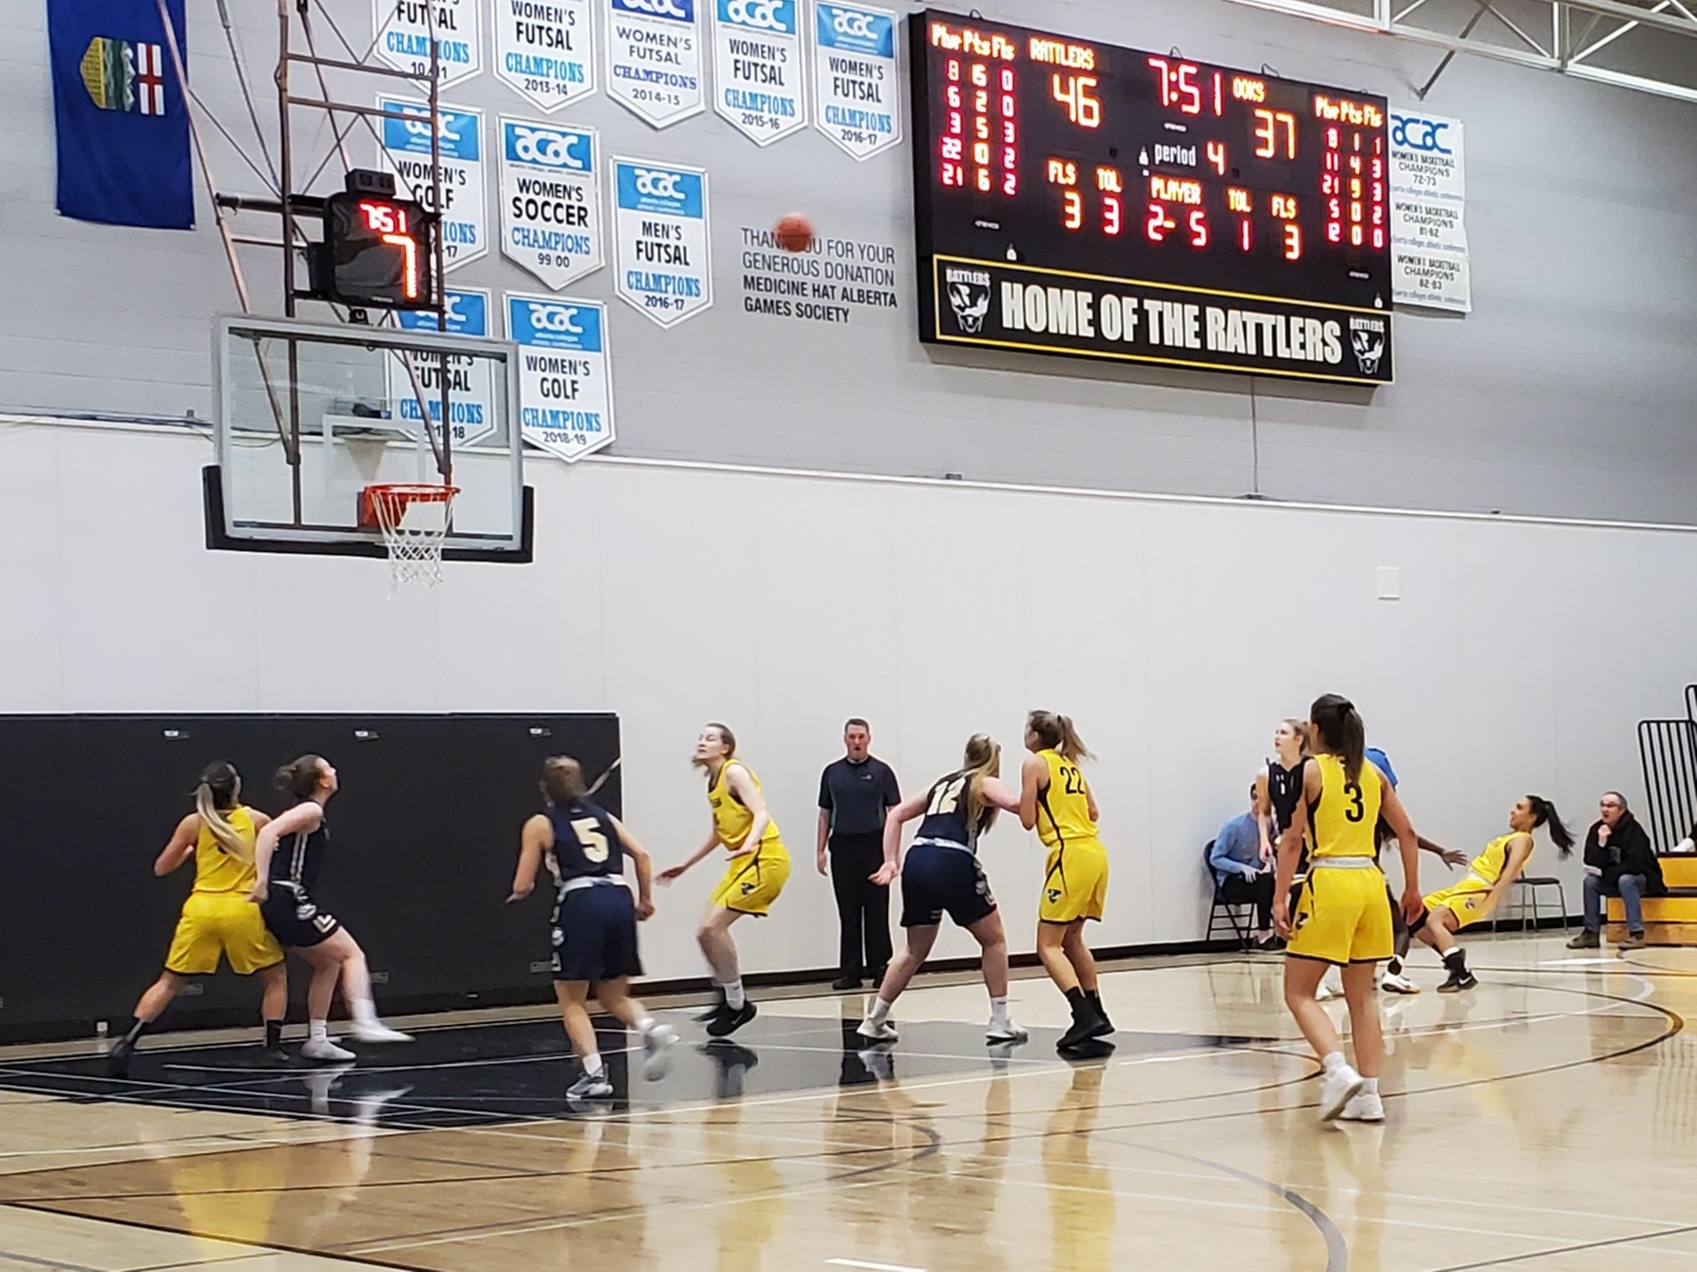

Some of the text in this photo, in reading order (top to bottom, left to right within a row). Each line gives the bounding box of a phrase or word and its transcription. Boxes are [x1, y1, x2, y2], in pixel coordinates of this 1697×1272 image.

[397, 0, 457, 31] FUTAL
[511, 0, 575, 26] WOMEN'S
[387, 31, 470, 64] CHAMIONS
[516, 21, 573, 51] FUTSAL
[616, 25, 692, 51] WOMEN'S
[629, 45, 682, 66] FUTSAL
[729, 38, 787, 63] WOMEN'S
[1029, 37, 1095, 70] RATTLERS
[505, 52, 584, 84] CHAMPIONS
[613, 64, 697, 90] CHAMPIONS
[733, 59, 785, 87] FUTSAL
[828, 56, 884, 81] WOMEN'S
[524, 78, 568, 96] 2013-14
[632, 88, 680, 106] 2014-15
[833, 76, 882, 103] FUTSAL
[947, 85, 961, 108] 6
[975, 90, 987, 113] 2
[1053, 73, 1100, 128] 46
[1148, 57, 1222, 117] 7:51
[724, 88, 796, 117] CHAMPIONS
[741, 112, 780, 130] 2015-16
[825, 104, 892, 134] CHAMPIONS
[950, 111, 1015, 143] 3 5 3
[514, 126, 584, 168] acac
[841, 128, 878, 146] 2016-17
[1254, 108, 1295, 160] 37
[1004, 146, 1016, 169] 2
[1154, 142, 1197, 167] period
[1207, 141, 1225, 176] 4
[1349, 155, 1361, 175] 4
[1372, 158, 1382, 179] 3
[942, 162, 1016, 196] 21 6 2
[1398, 161, 1450, 178] CHAMPIONS
[1413, 174, 1437, 186] 72-73
[413, 184, 454, 210] GOF
[517, 177, 584, 202] WOMEN'S
[634, 168, 686, 200] acac
[1048, 159, 1076, 186] FLS
[1151, 176, 1201, 205] PLAYER
[1271, 195, 1297, 220] FLS
[1322, 173, 1339, 195] 21
[1372, 181, 1382, 202] 3
[511, 196, 589, 228] SOCCER
[1064, 190, 1081, 229] 3
[1103, 196, 1120, 235] 3
[1242, 219, 1250, 251] 1
[1284, 223, 1300, 260] 3
[1403, 213, 1454, 229] CHAMPIONS
[511, 226, 591, 256] CHAMPIONS
[642, 220, 682, 241] MEN'S
[635, 239, 691, 267] FUTSAL
[741, 226, 786, 251] THAN
[827, 239, 854, 259] FOR
[857, 243, 895, 264] YOUR
[382, 234, 417, 298] 7
[537, 252, 570, 268] 99 00
[742, 251, 895, 287] GENEROUS DONATION
[1404, 266, 1455, 281] CHAMPIONS
[627, 269, 701, 298] CHAMPIONS
[743, 274, 898, 308] MEDICINE HAT ALBERTA
[644, 294, 685, 311] 2016-17
[744, 296, 850, 323] GAMES SOCIETY
[528, 303, 584, 333] acac
[1001, 281, 1343, 364] HOME OF THE RATTLERS
[525, 354, 591, 377] WOMEN'S
[540, 377, 579, 401] GOLF
[400, 398, 484, 425] CHMIONS
[522, 407, 602, 433] CHAMPIONS
[542, 431, 587, 446] 2018-19
[1059, 766, 1085, 794] 22
[926, 777, 966, 816] 12
[1344, 783, 1365, 823] 3
[569, 817, 610, 863] 5
